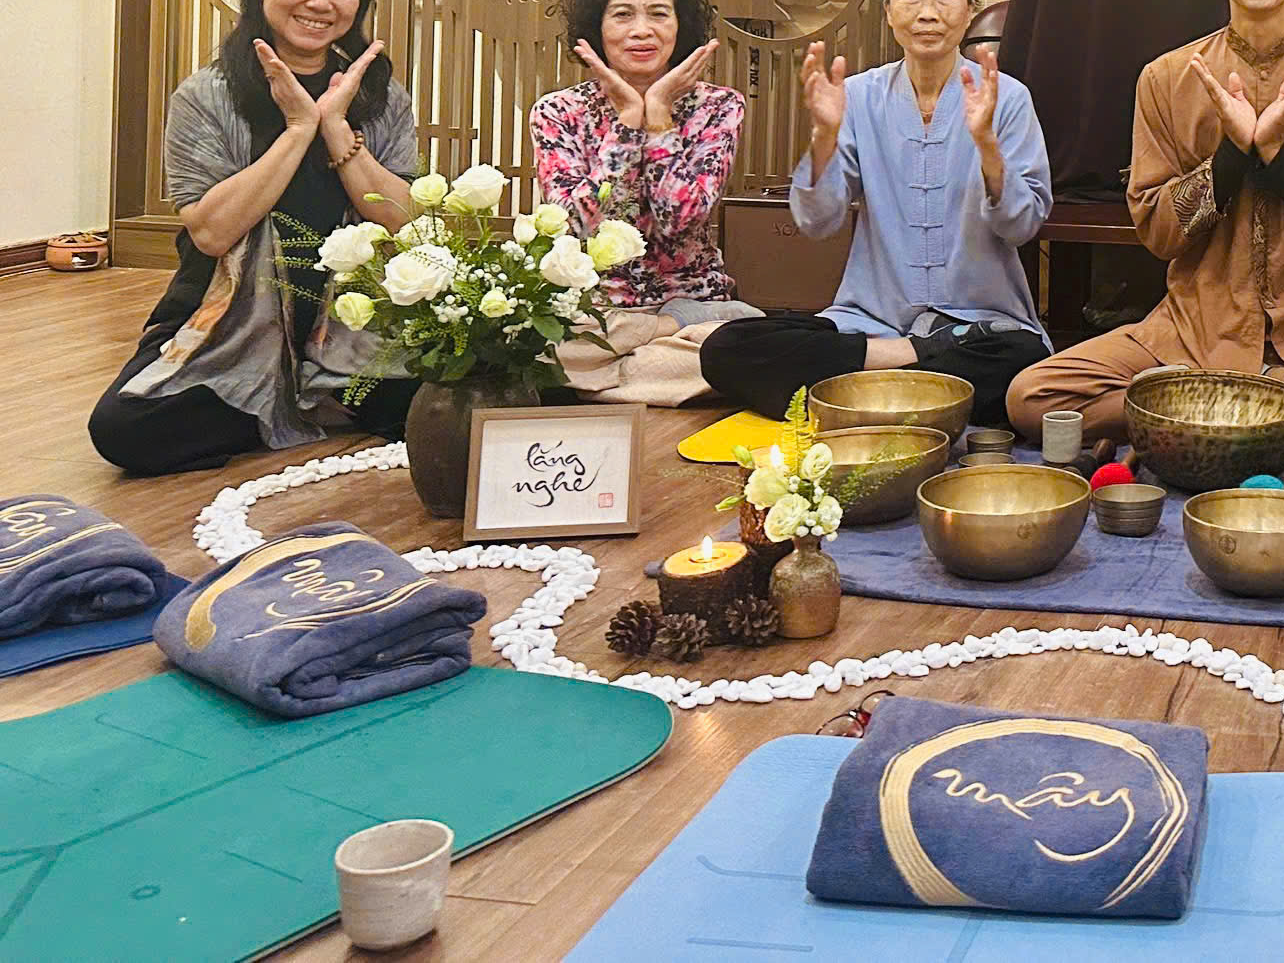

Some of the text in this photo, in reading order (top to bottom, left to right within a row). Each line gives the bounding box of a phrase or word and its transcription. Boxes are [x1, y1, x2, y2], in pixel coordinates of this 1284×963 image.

[526, 440, 586, 475] lắng
[512, 464, 603, 508] nghe
[932, 768, 1136, 862] mây
